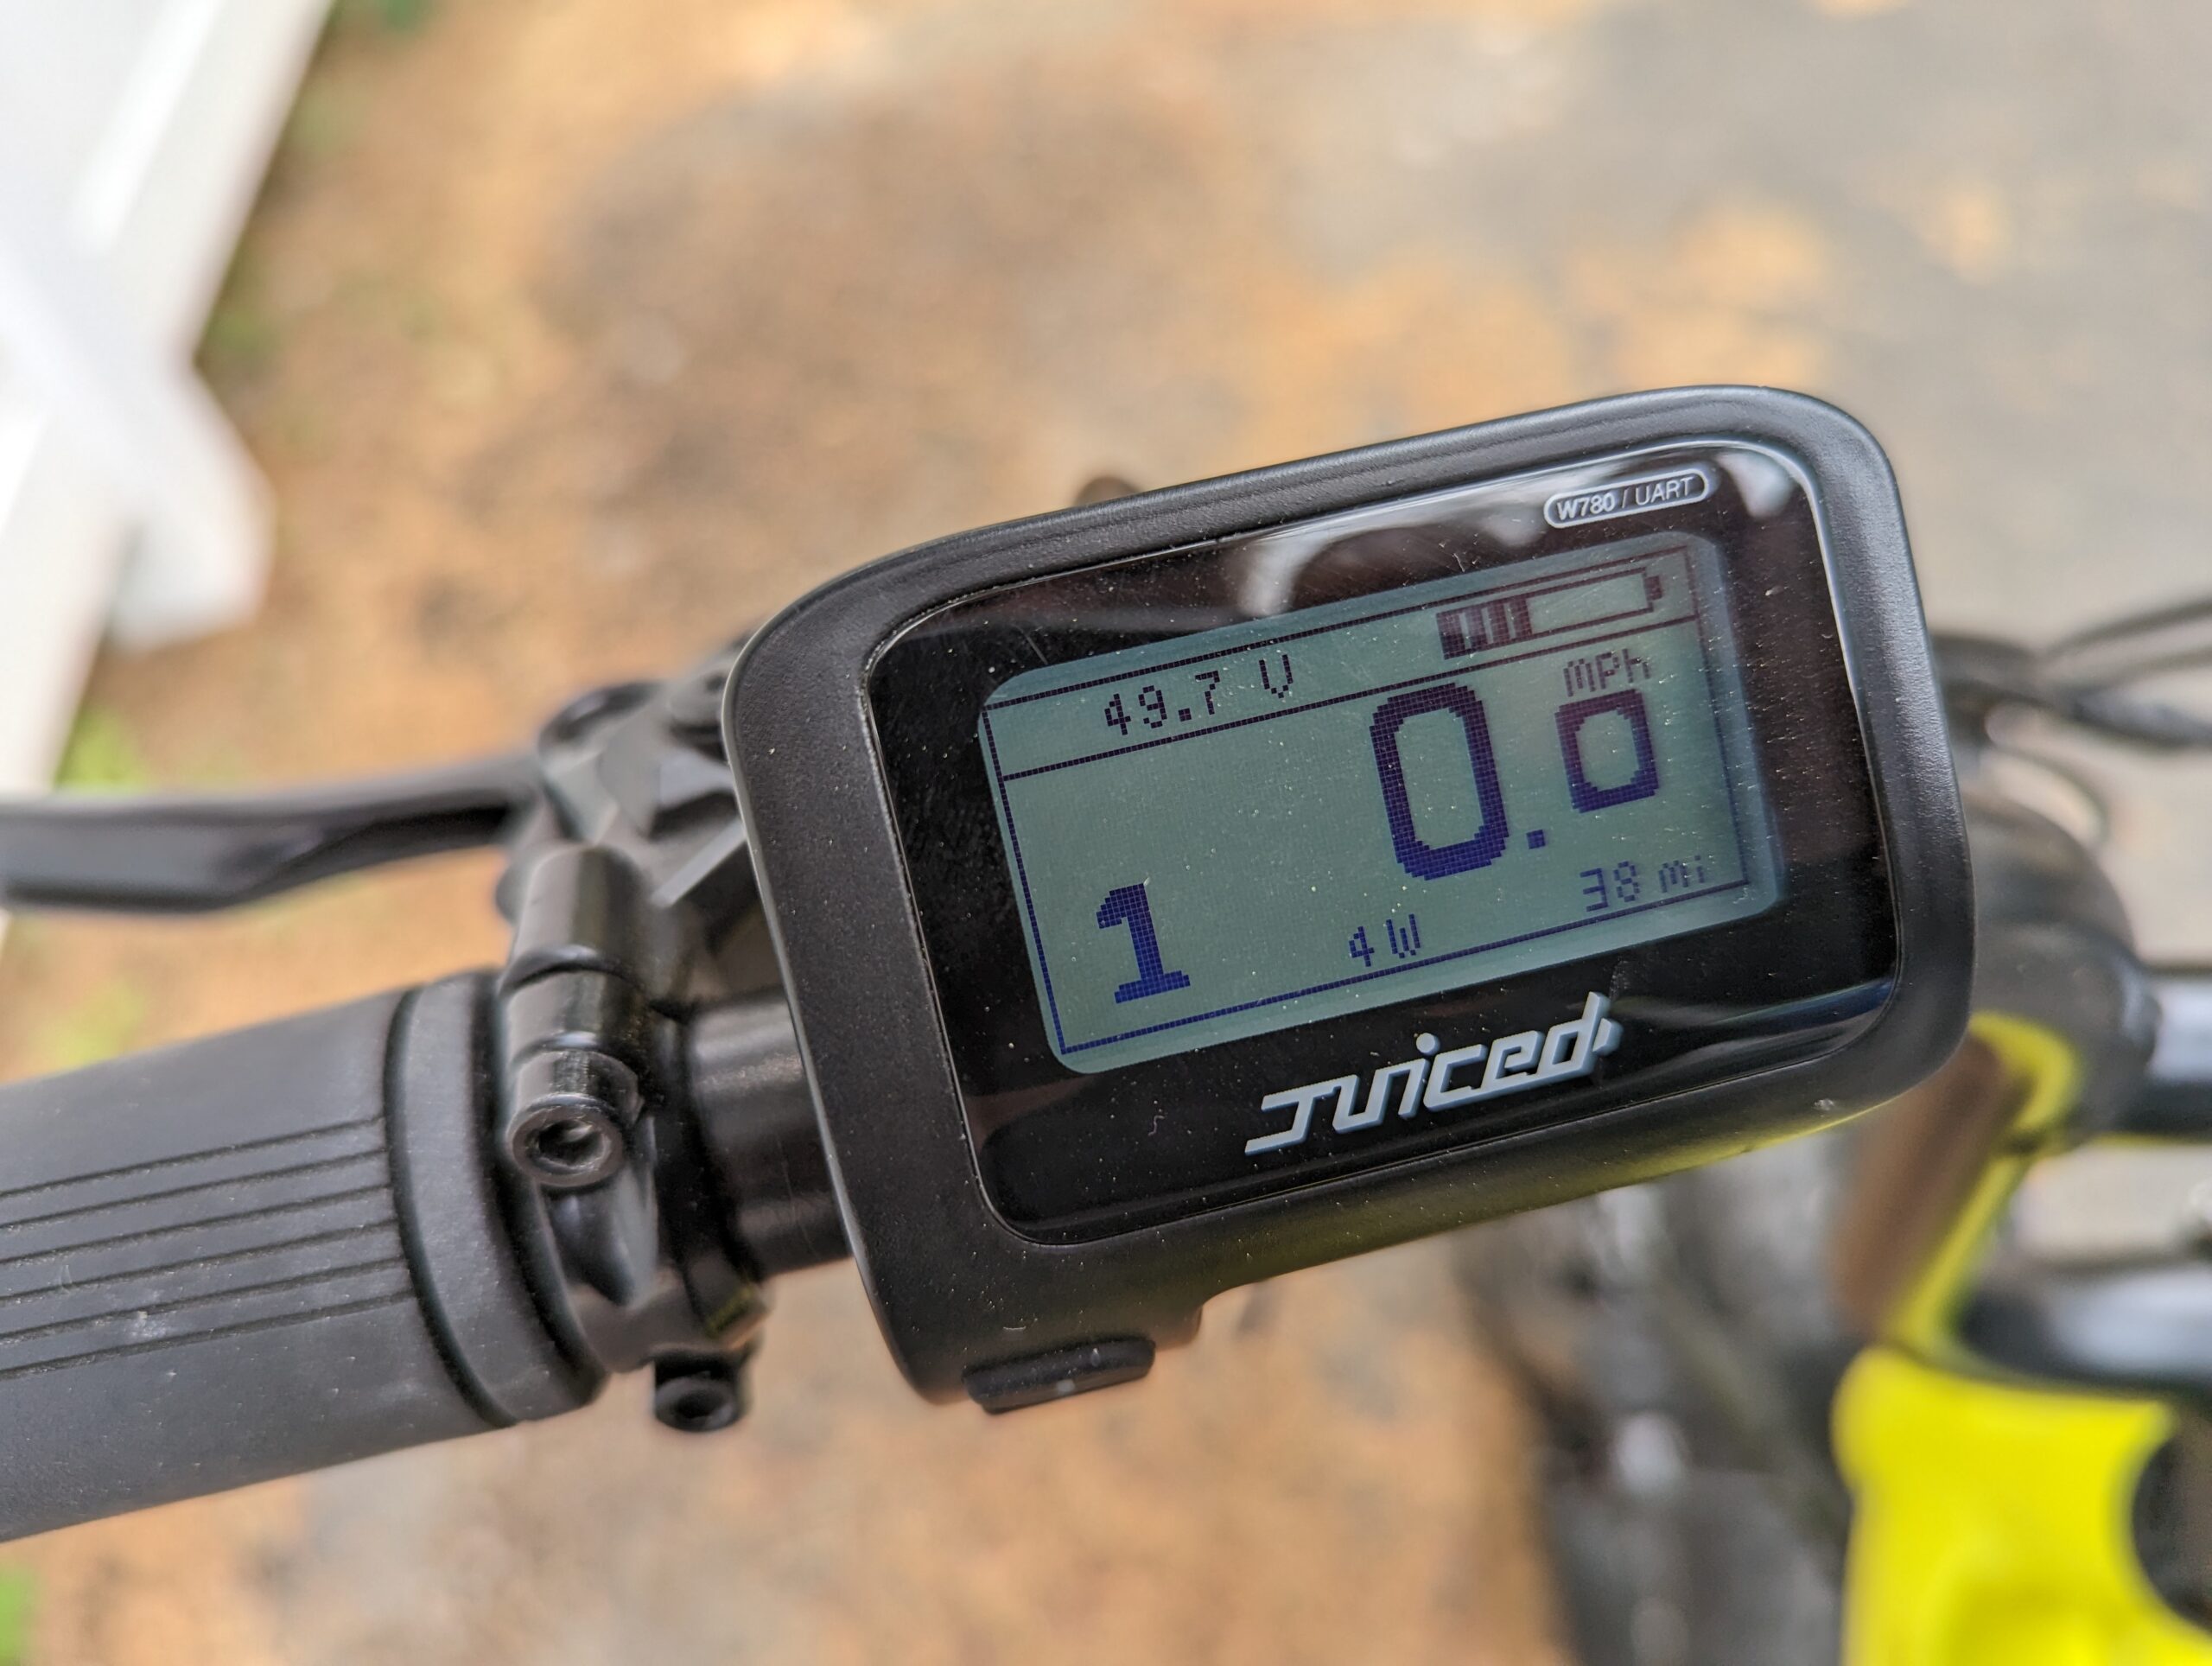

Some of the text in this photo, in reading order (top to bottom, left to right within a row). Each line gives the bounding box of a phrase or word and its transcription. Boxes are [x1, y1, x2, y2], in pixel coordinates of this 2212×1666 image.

[1556, 493, 1616, 522] W780
[1634, 476, 1694, 506] UART
[1104, 654, 1294, 736] 49.7 V
[1579, 861, 1641, 912] 38
[1096, 882, 1191, 1004] 1
